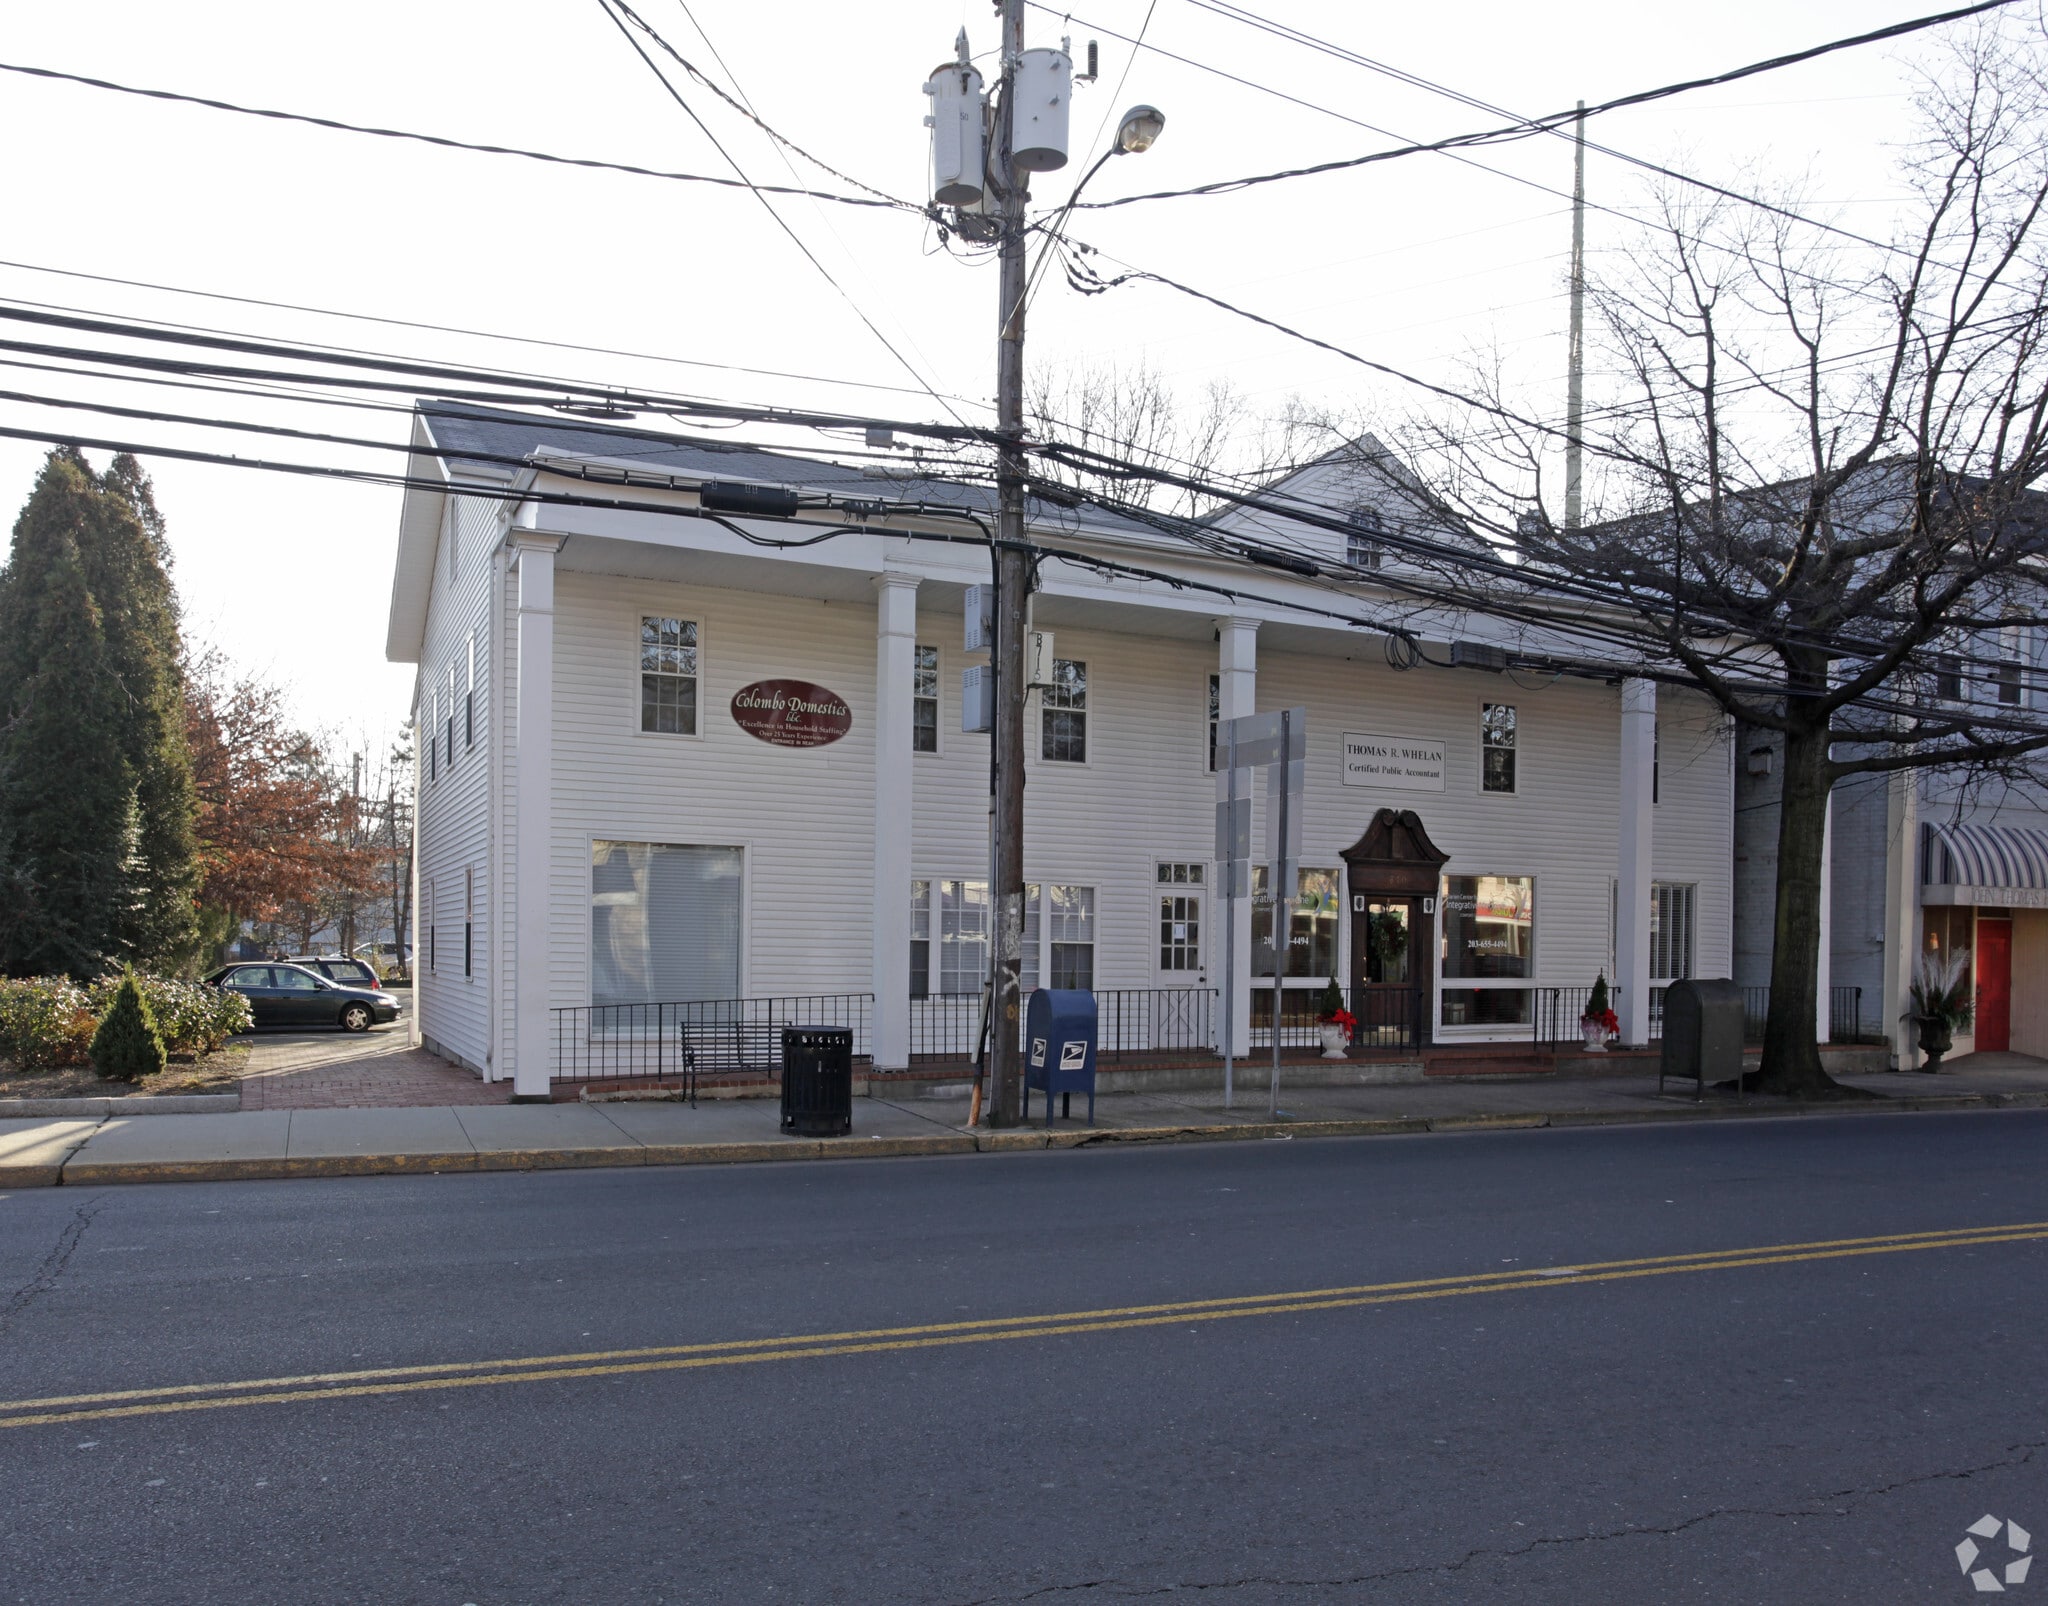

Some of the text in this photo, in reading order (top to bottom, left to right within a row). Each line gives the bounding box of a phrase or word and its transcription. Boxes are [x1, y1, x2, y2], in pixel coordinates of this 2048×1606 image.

[736, 688, 848, 716] Colombo Domestics
[776, 722, 784, 730] in
[785, 723, 818, 733] Household
[759, 730, 773, 738] Over
[781, 731, 796, 739] Years
[796, 733, 827, 741] Experience
[771, 738, 795, 746] ENTRANCE
[1346, 744, 1443, 761] THOMAS R. WHELAN
[1348, 763, 1441, 779] Certified Public Accountant
[1969, 887, 1994, 905] JOHN
[2000, 888, 2040, 905] THOMAS
[1467, 940, 1508, 949] 203-655-4494
